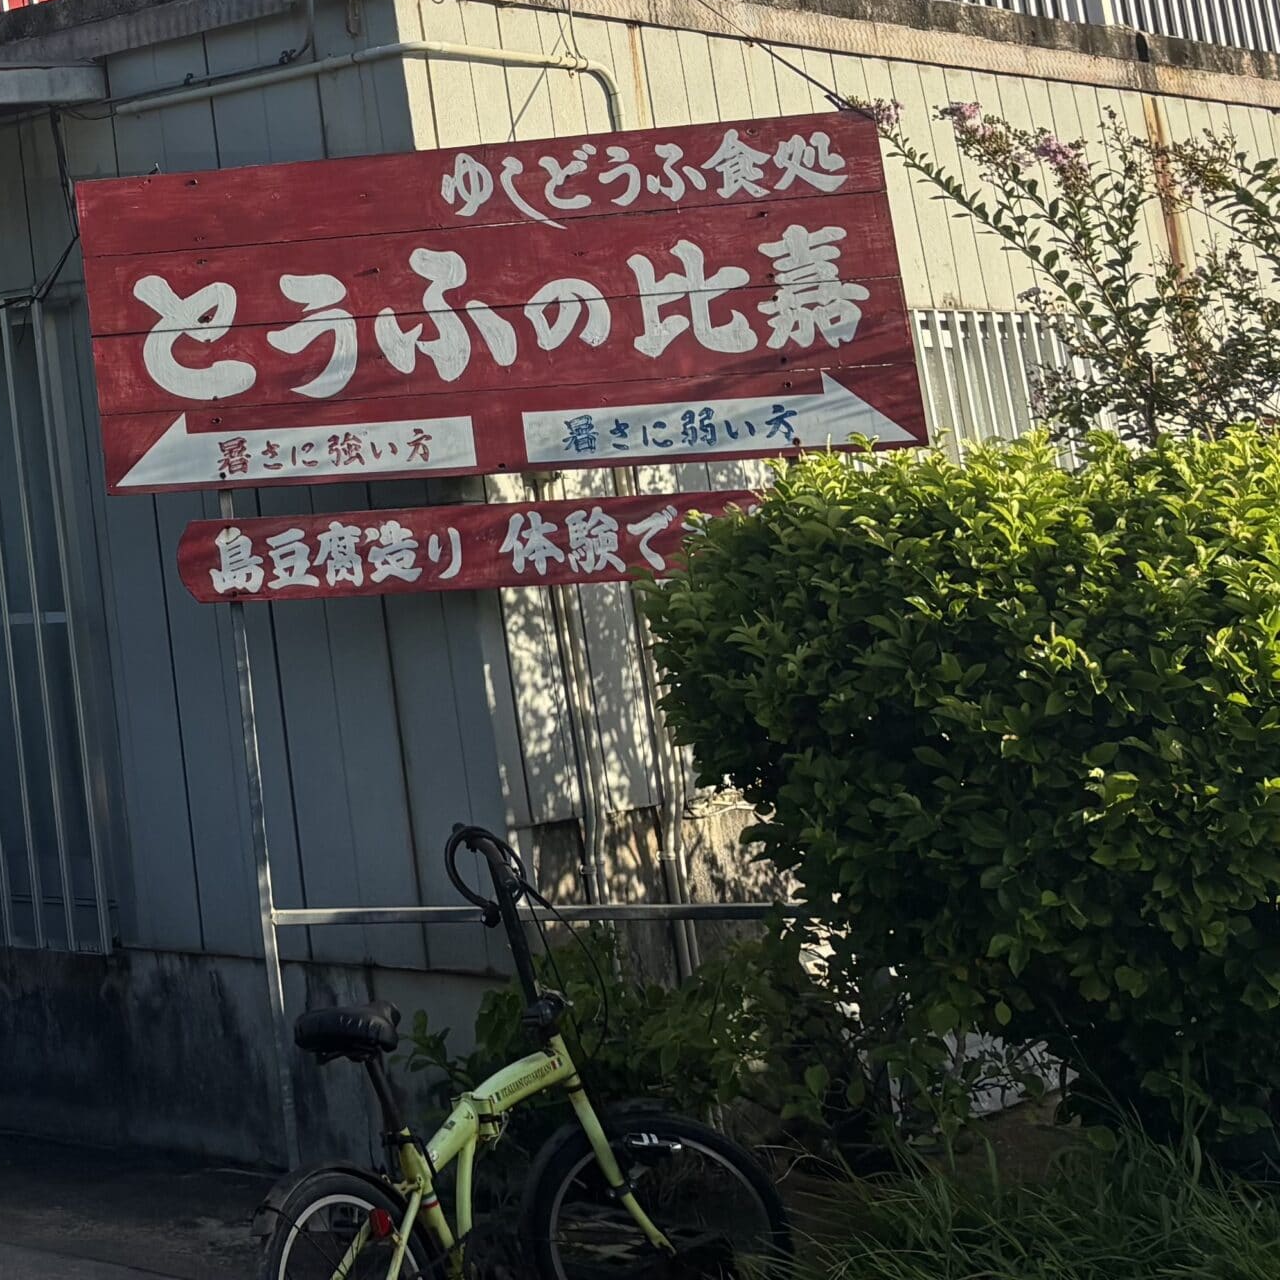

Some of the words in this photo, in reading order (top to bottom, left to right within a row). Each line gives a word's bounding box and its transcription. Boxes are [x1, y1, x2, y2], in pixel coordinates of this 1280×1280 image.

[440, 127, 849, 229] ゆしどうふ食処
[133, 225, 871, 400] とうふの比嘉
[218, 428, 432, 475] 暑さに強い方
[563, 404, 797, 454] 暑さに弱い方
[210, 521, 462, 594] 島豆腐造り
